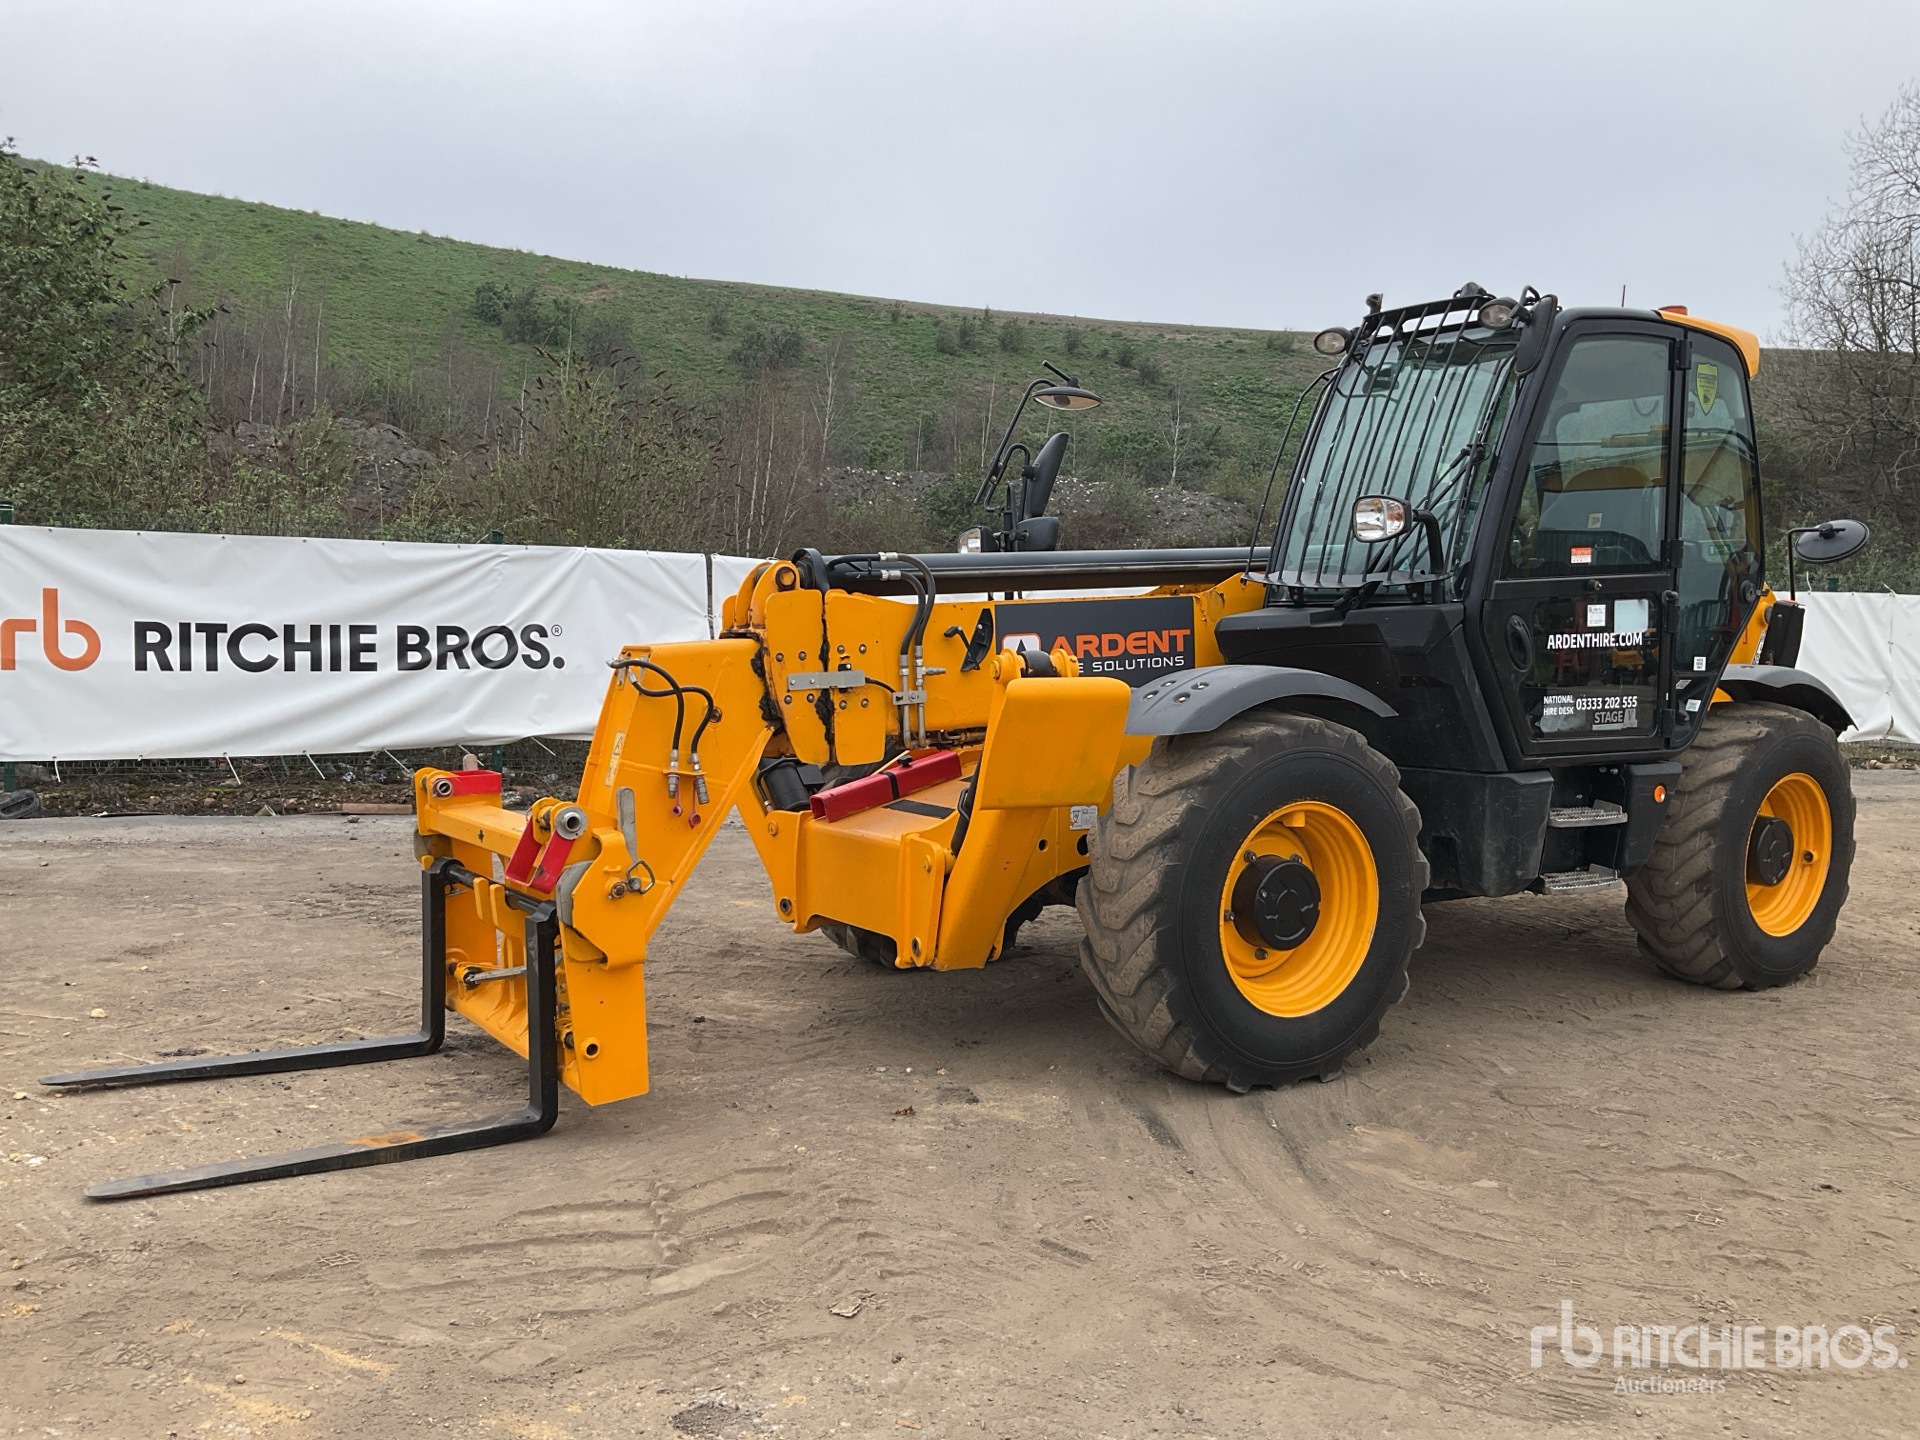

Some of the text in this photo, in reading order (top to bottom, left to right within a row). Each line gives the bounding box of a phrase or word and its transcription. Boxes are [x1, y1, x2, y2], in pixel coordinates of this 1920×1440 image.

[133, 621, 378, 673] RITCHIE
[1051, 629, 1190, 657] ARDENT
[1547, 632, 1643, 649] ARDENTHIRE.COM
[1092, 656, 1184, 672] SOLUTIONS
[1543, 695, 1574, 704] NATIONAL
[1576, 696, 1637, 710] 03333 202 555
[1543, 706, 1574, 716] HIRE DESK
[1594, 711, 1623, 723] STAGE
